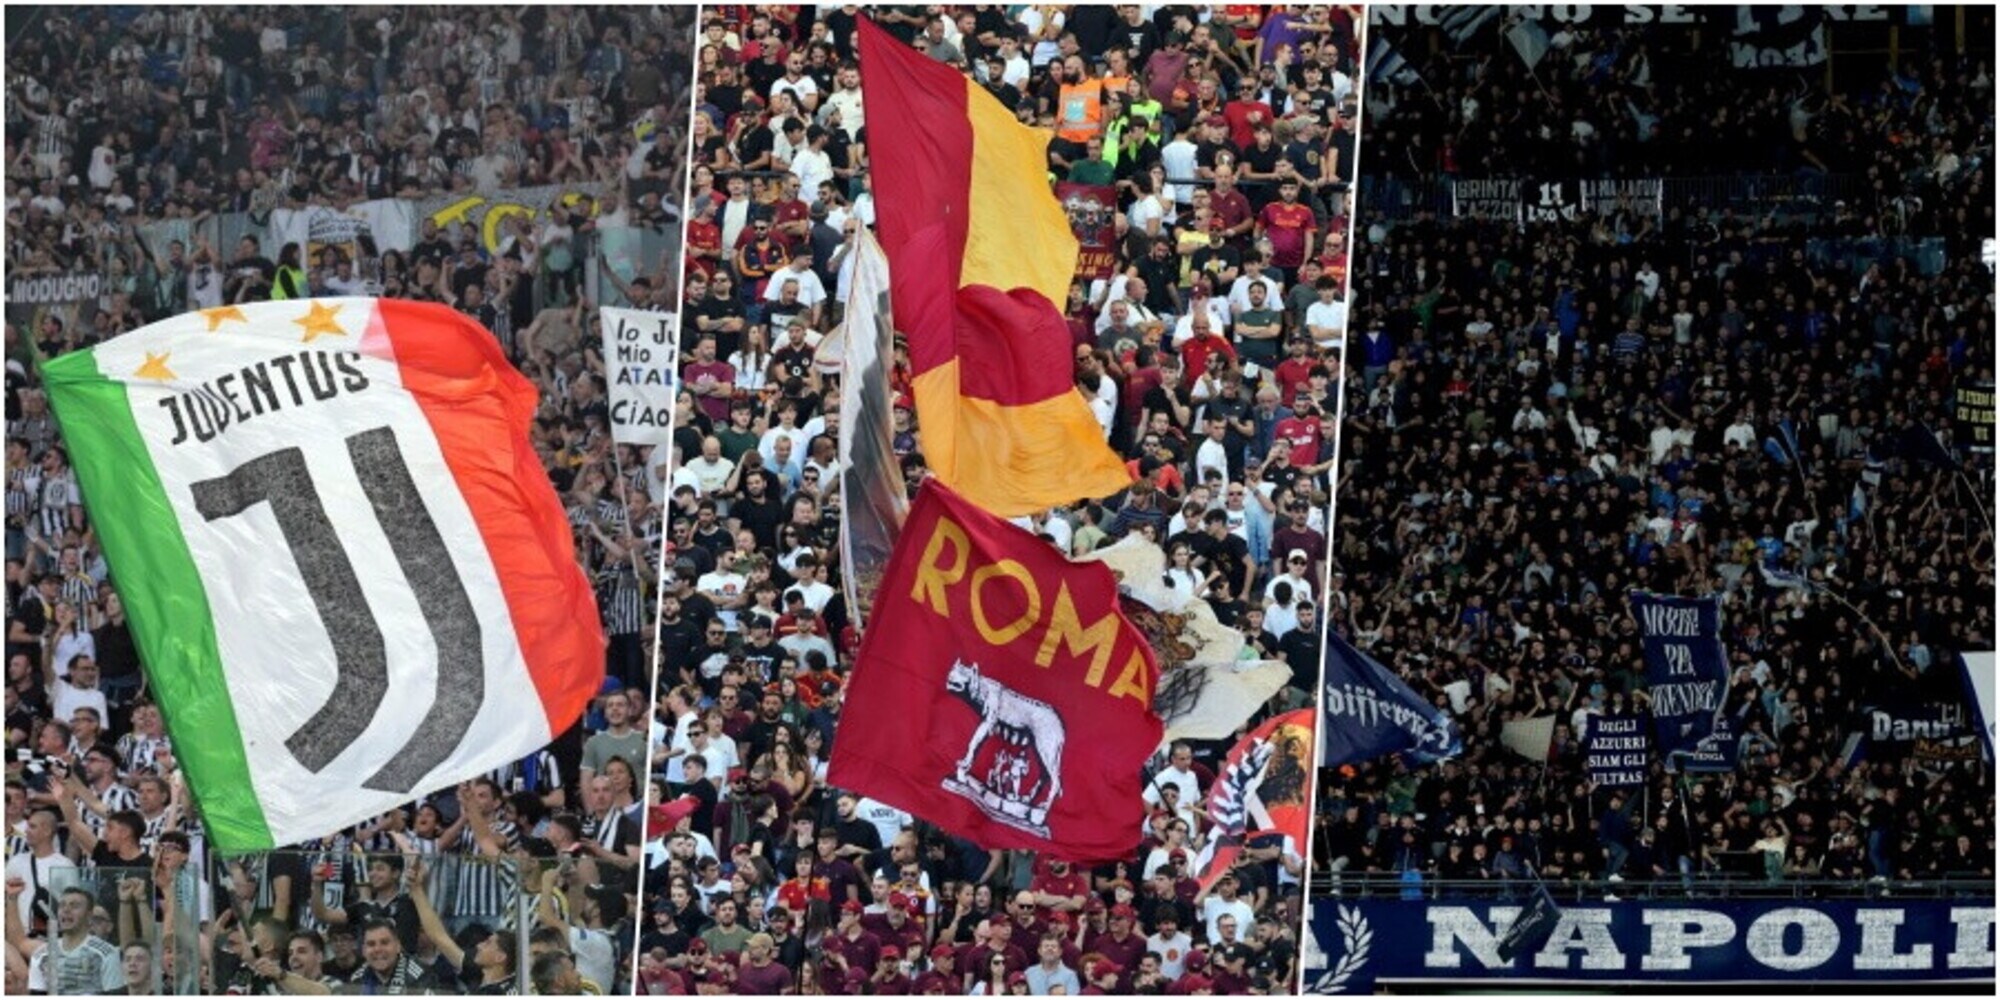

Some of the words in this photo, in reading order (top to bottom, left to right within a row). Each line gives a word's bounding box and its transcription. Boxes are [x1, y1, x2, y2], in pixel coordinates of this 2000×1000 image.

[158, 350, 370, 446] JUVENTUS
[910, 515, 1148, 712] ROMA
[1597, 719, 1637, 733] DEGLI
[1590, 736, 1646, 750] AZZURRI
[1588, 753, 1621, 768] SIAM
[1623, 753, 1646, 767] GLI
[1593, 771, 1643, 786] ULTRAS
[1423, 906, 1996, 971] NAPOLI
